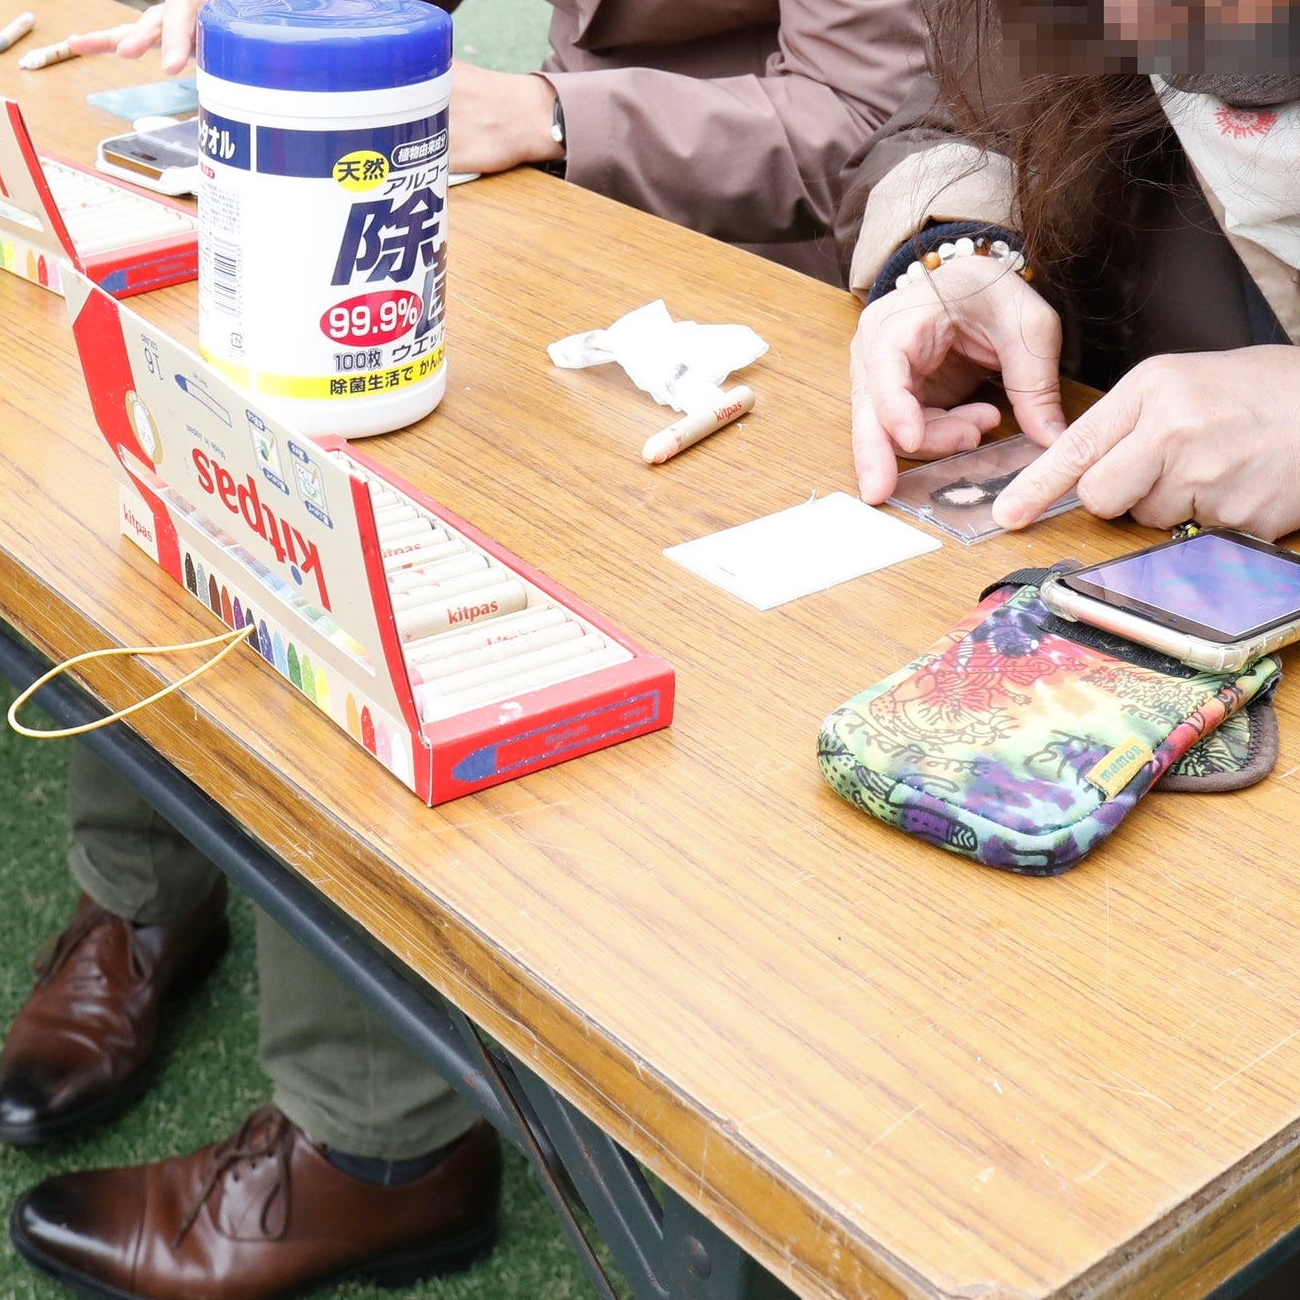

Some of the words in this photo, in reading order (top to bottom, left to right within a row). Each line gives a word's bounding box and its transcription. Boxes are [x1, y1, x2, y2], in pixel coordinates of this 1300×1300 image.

[337, 158, 385, 183] 天然
[329, 295, 418, 339] 99.9%
[144, 347, 164, 381] 16
[334, 350, 383, 373] 100枚
[330, 365, 414, 396] 除菌生活で
[713, 401, 743, 422] kitpas
[123, 503, 153, 543] kitpas
[192, 448, 332, 613] kitpas
[447, 601, 499, 624] kitpas
